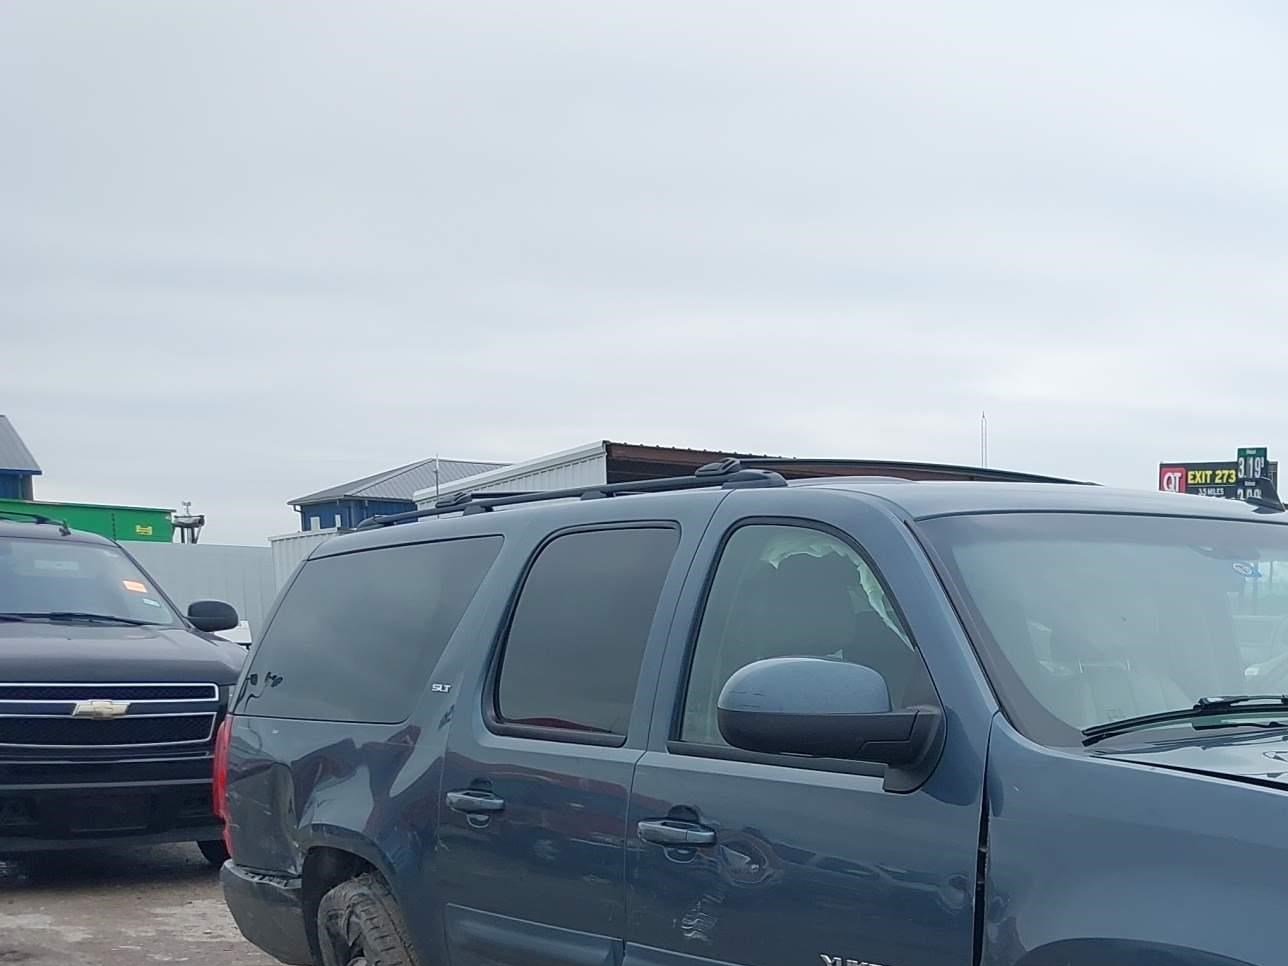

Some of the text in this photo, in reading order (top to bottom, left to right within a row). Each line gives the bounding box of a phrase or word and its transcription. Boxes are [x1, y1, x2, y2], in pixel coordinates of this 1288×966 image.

[1163, 472, 1182, 492] QT
[1187, 469, 1237, 484] EXIT 273
[1207, 487, 1225, 495] MILES
[431, 683, 451, 693] SLT
